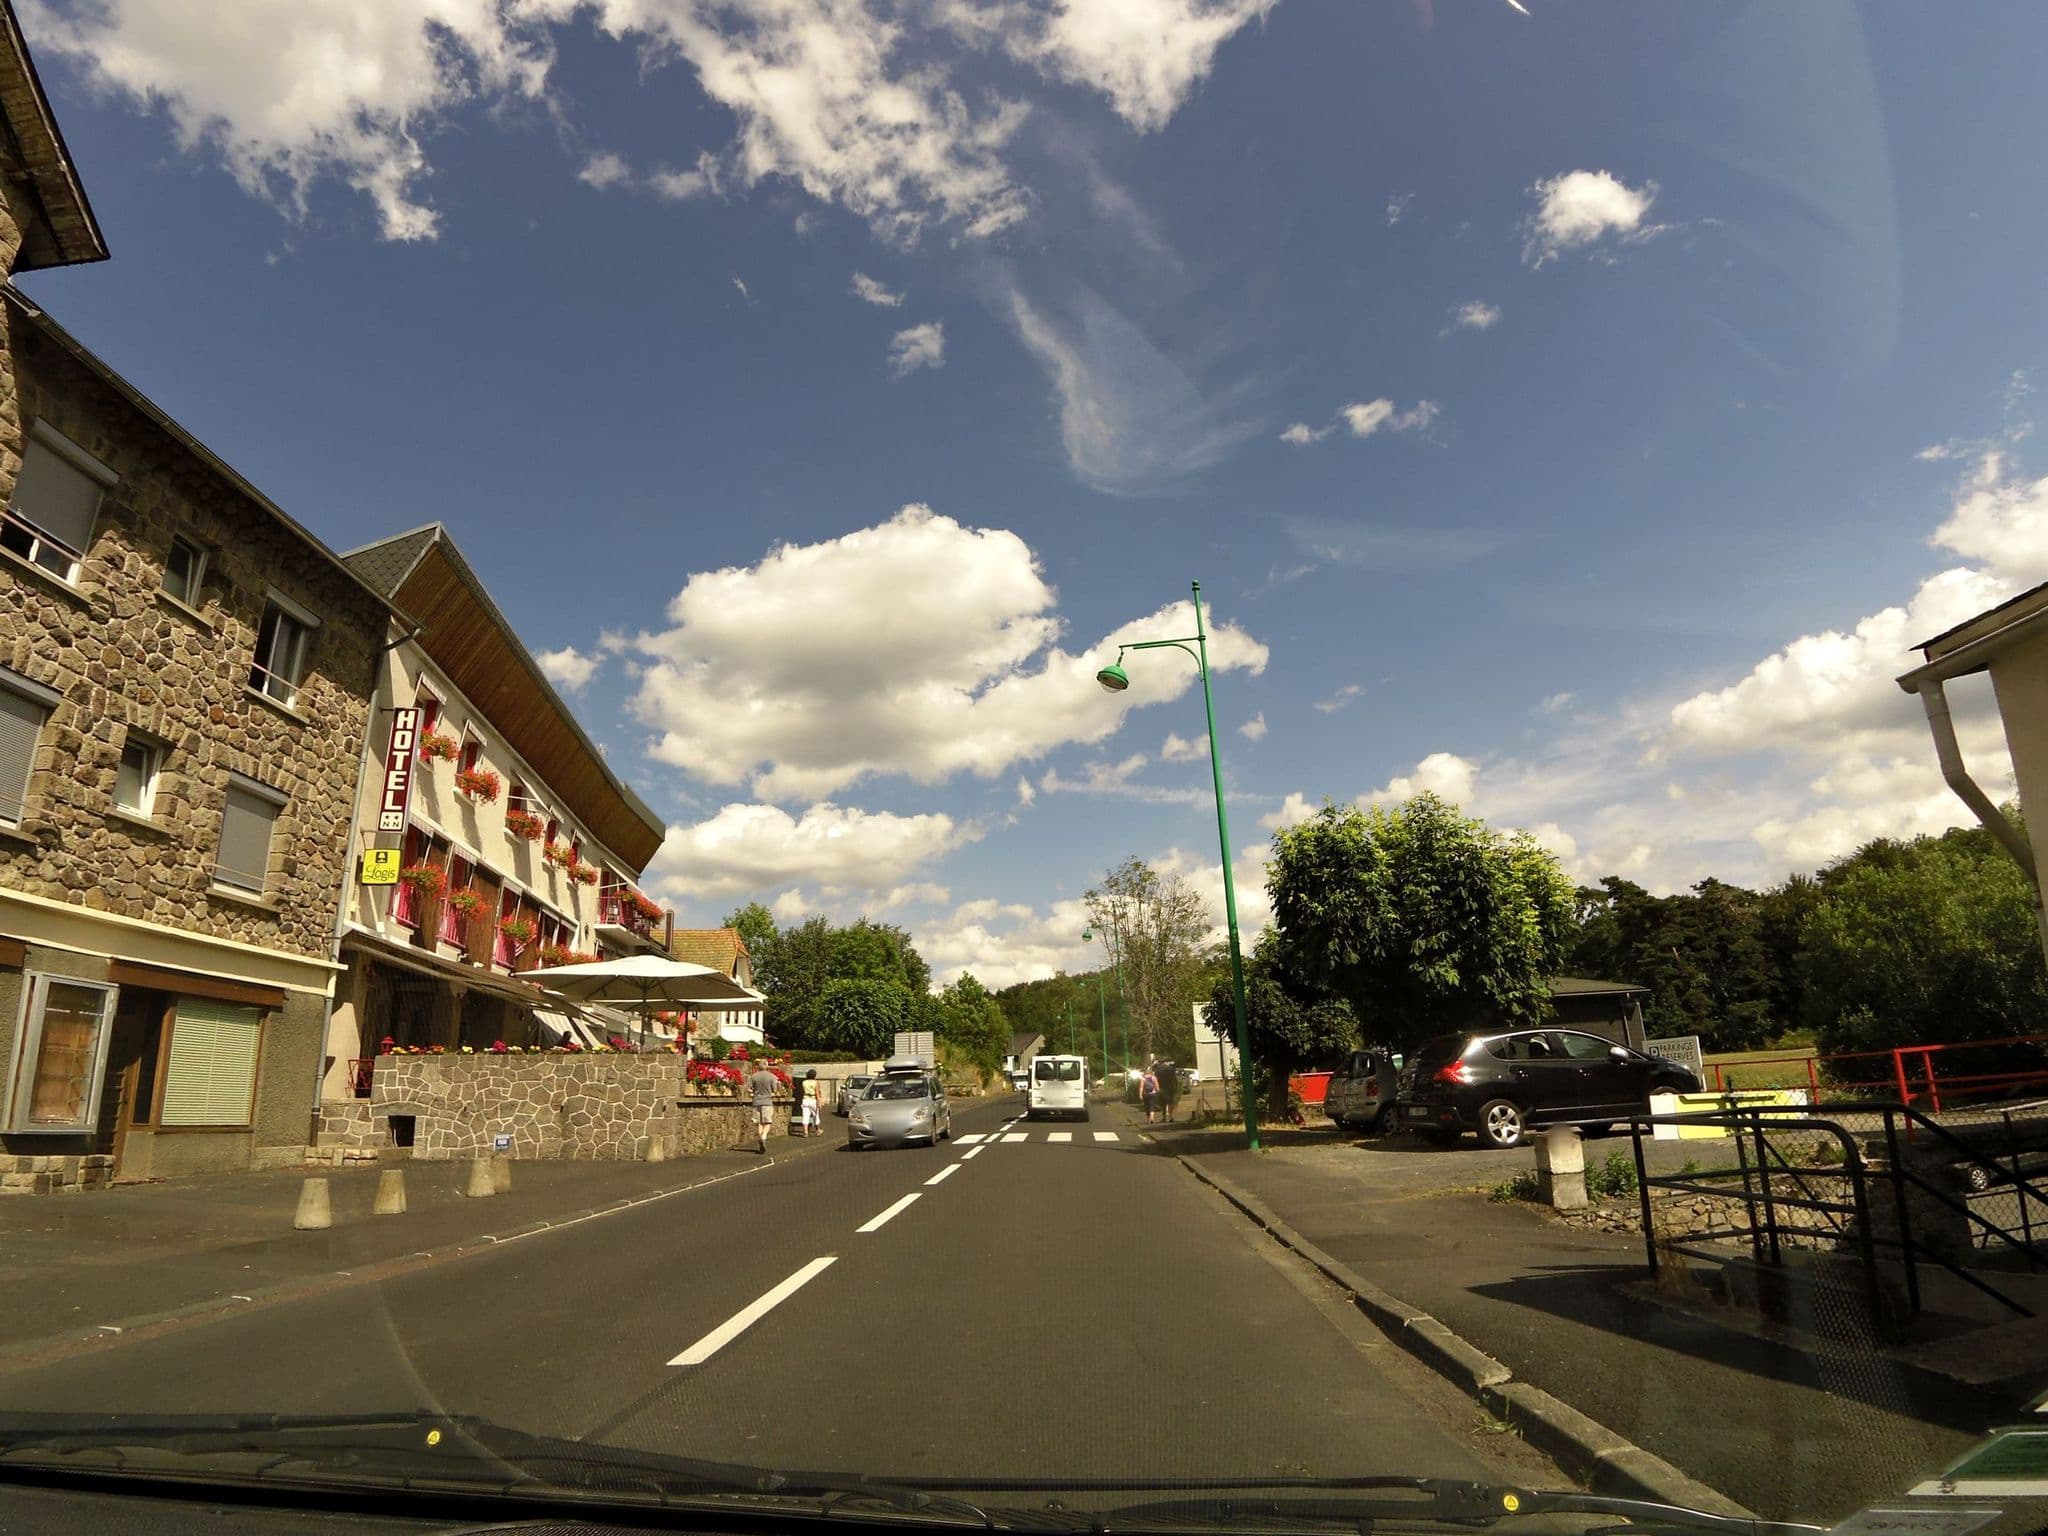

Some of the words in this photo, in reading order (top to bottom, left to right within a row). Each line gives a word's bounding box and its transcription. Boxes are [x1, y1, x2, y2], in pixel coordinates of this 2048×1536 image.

[384, 710, 416, 810] HOTEL
[363, 864, 396, 881] Logis
[1660, 1041, 1693, 1051] PARKINGS
